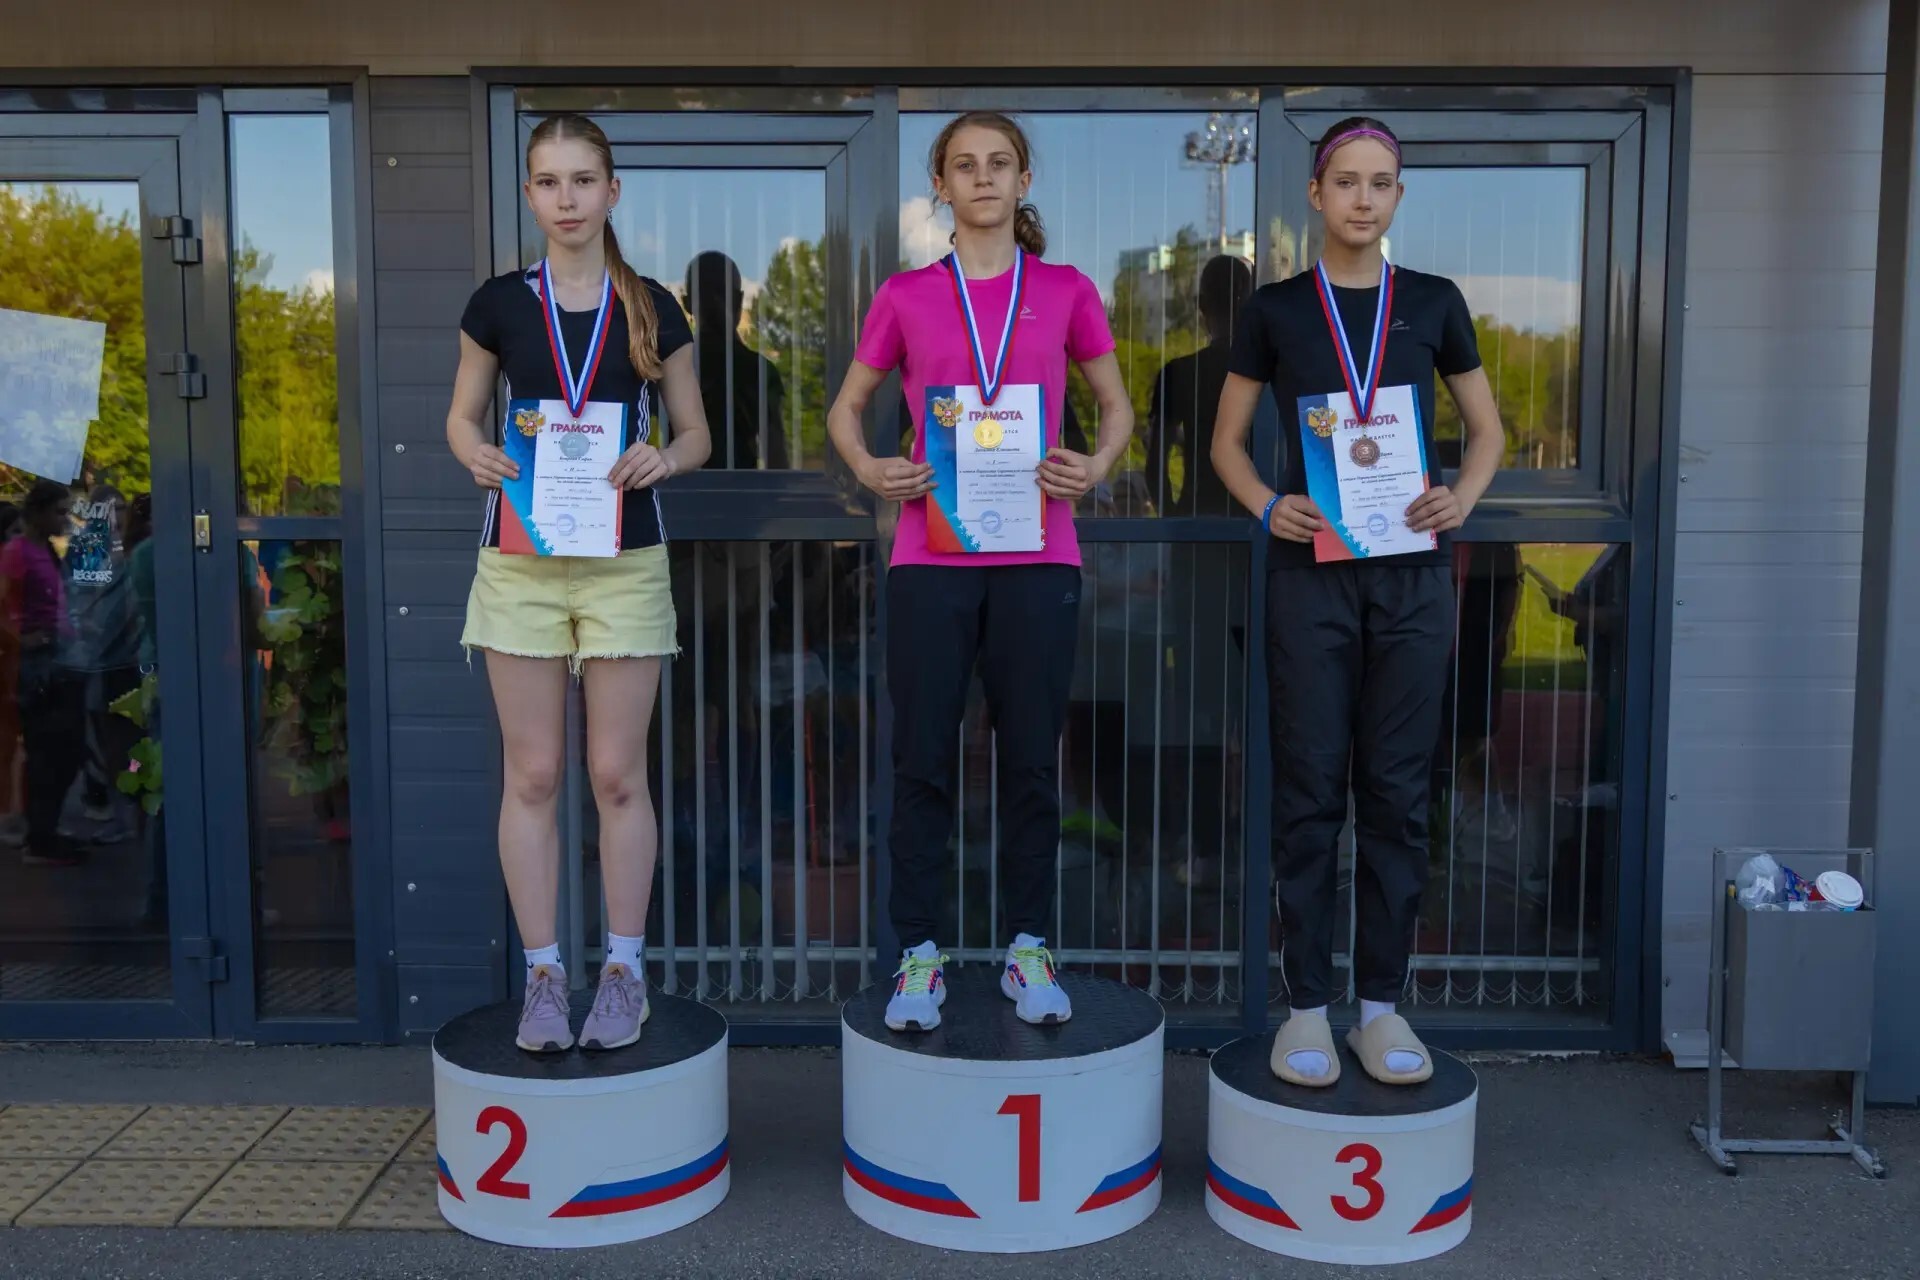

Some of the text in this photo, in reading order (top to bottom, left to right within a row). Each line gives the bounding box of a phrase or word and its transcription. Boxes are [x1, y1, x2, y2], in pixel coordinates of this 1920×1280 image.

[550, 423, 604, 434] ГРАМОТА
[969, 410, 1024, 421] ГРАМОТА
[476, 1105, 530, 1200] 2
[996, 1094, 1041, 1202] 1
[1330, 1143, 1385, 1221] 3
